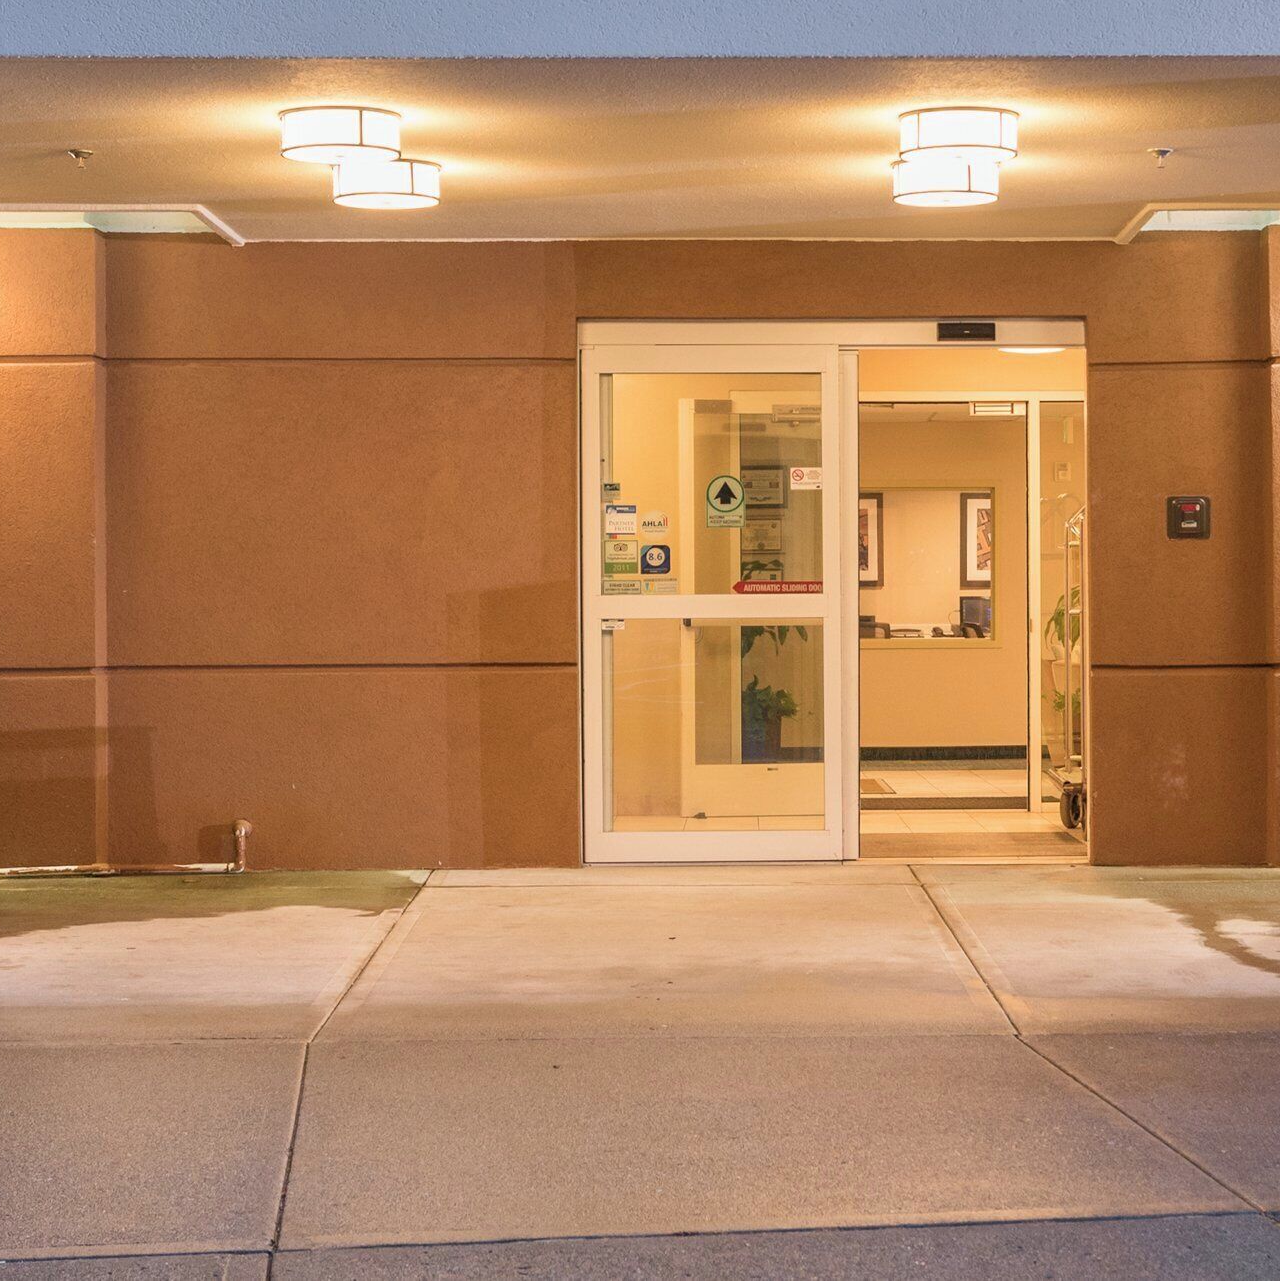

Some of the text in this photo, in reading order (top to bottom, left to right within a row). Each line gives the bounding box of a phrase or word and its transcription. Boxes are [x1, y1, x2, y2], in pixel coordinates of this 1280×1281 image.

[648, 552, 663, 561] 8.6
[743, 583, 780, 592] AUTOMATIC
[781, 583, 807, 592] SLIDING
